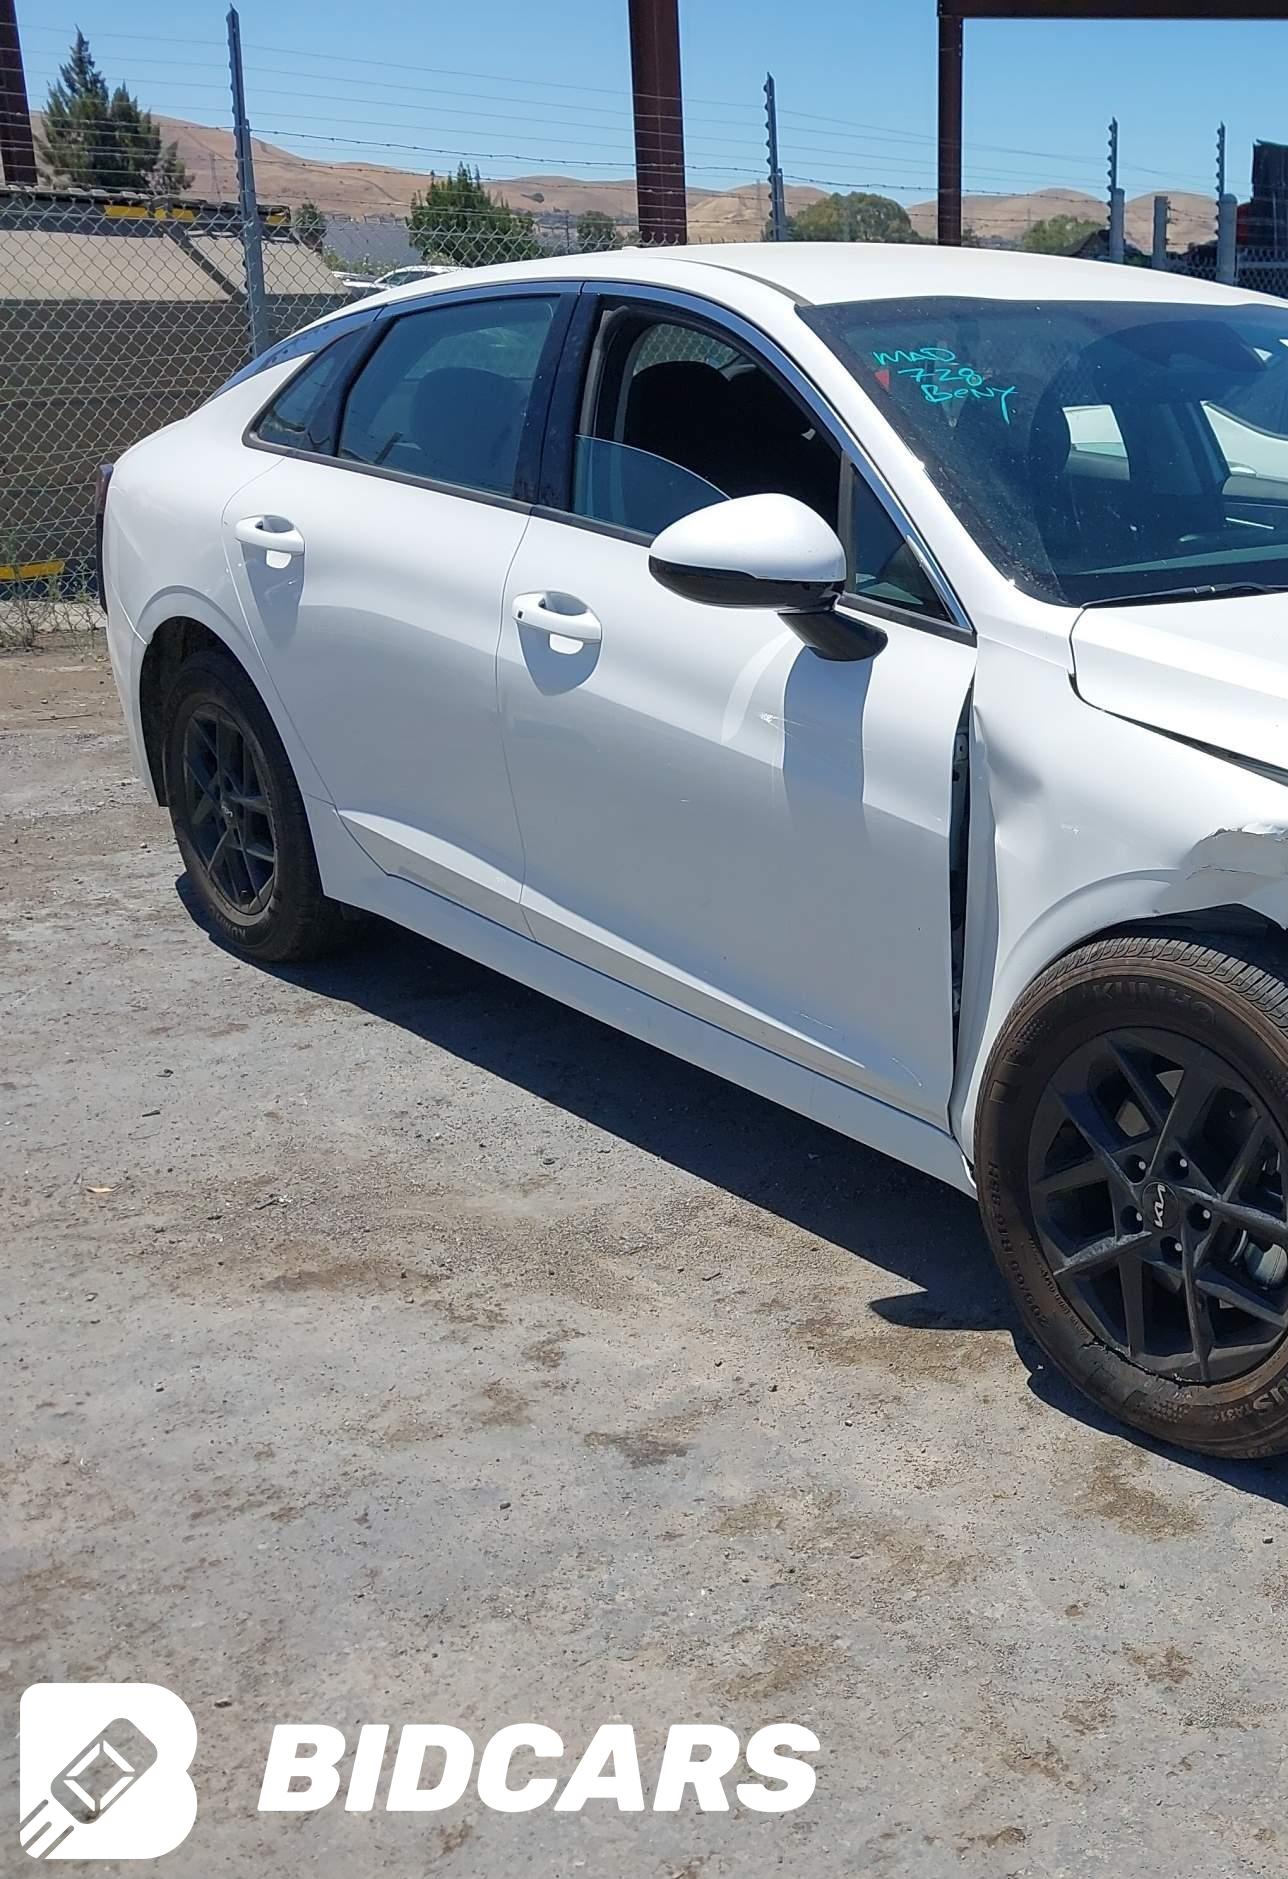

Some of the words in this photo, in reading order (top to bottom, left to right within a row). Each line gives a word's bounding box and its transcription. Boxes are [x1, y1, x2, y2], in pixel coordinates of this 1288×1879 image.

[898, 367, 984, 387] 728
[1091, 981, 1217, 1025] KUMHO
[1154, 1184, 1166, 1228] KIA
